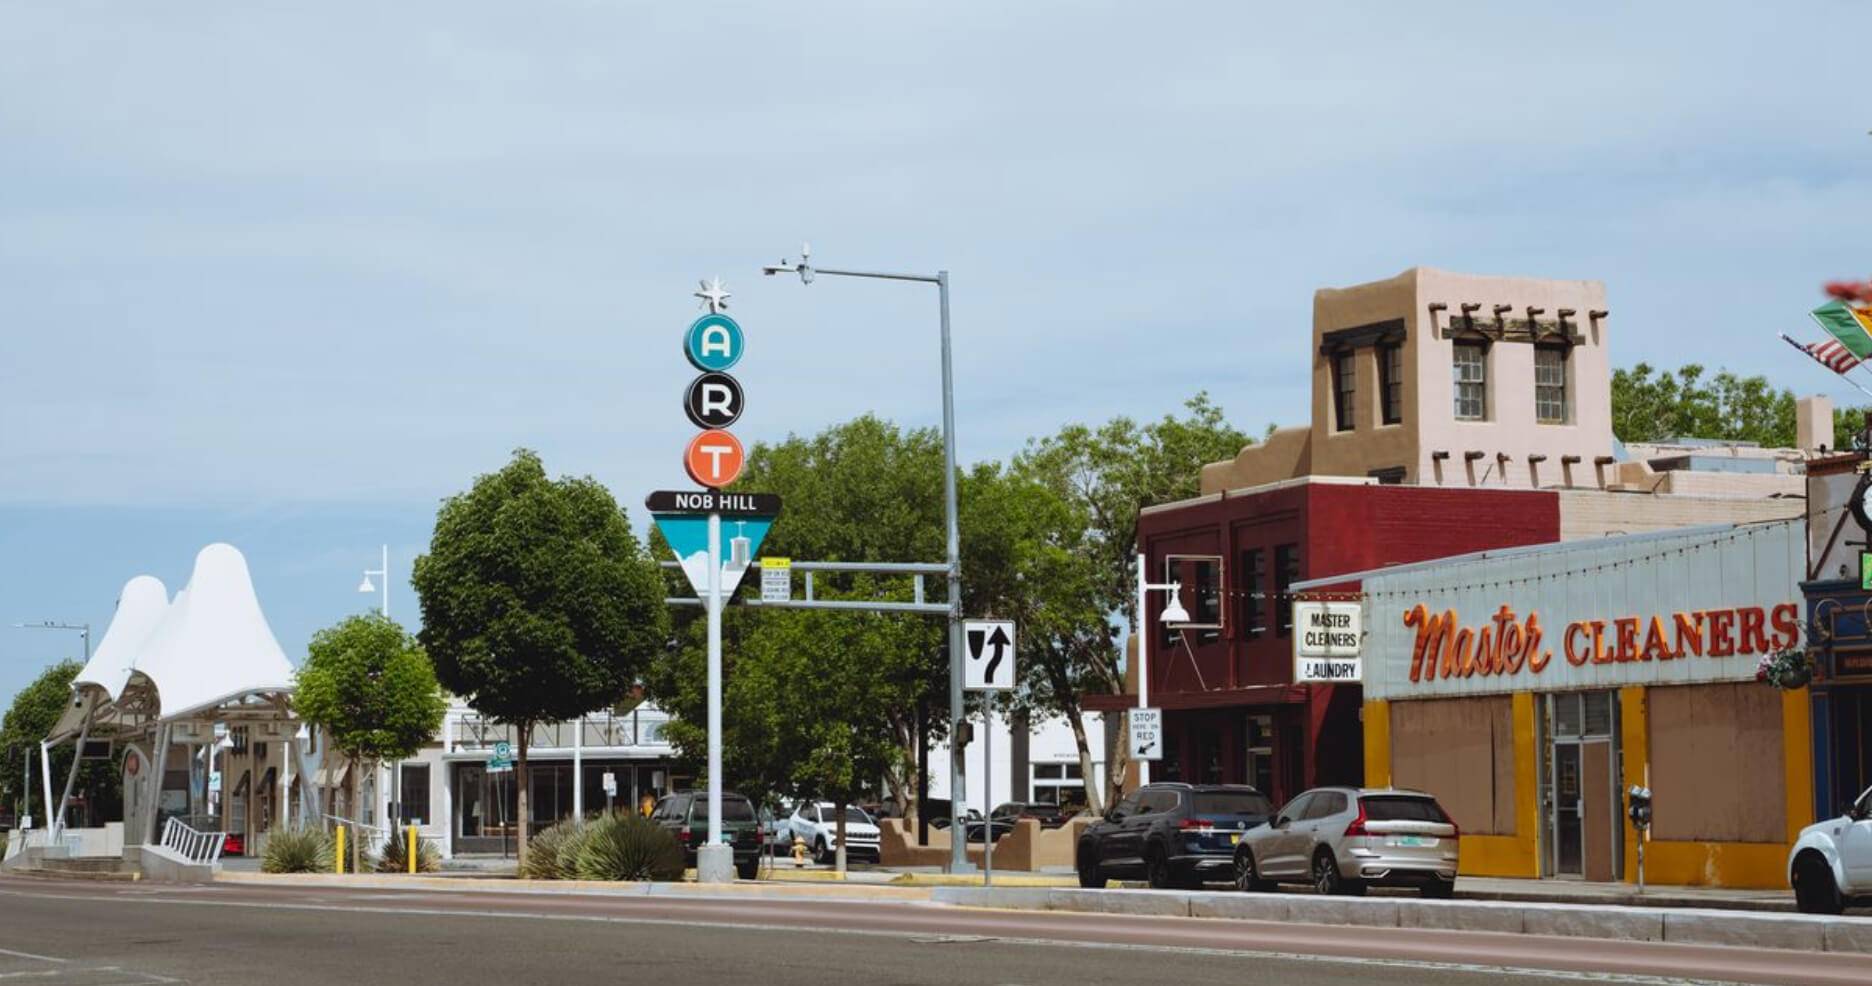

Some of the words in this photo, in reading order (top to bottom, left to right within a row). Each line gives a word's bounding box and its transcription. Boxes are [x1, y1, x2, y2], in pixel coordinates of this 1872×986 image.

[676, 493, 713, 509] NOB
[719, 495, 757, 510] HILL
[1311, 613, 1350, 628] MASTER
[1305, 631, 1357, 647] CLEANERS
[1404, 602, 1552, 683] Master
[1563, 603, 1799, 667] CLEANERS
[1305, 663, 1356, 678] LAUNDRY
[1133, 712, 1157, 721] STOP
[1136, 731, 1155, 740] RED
